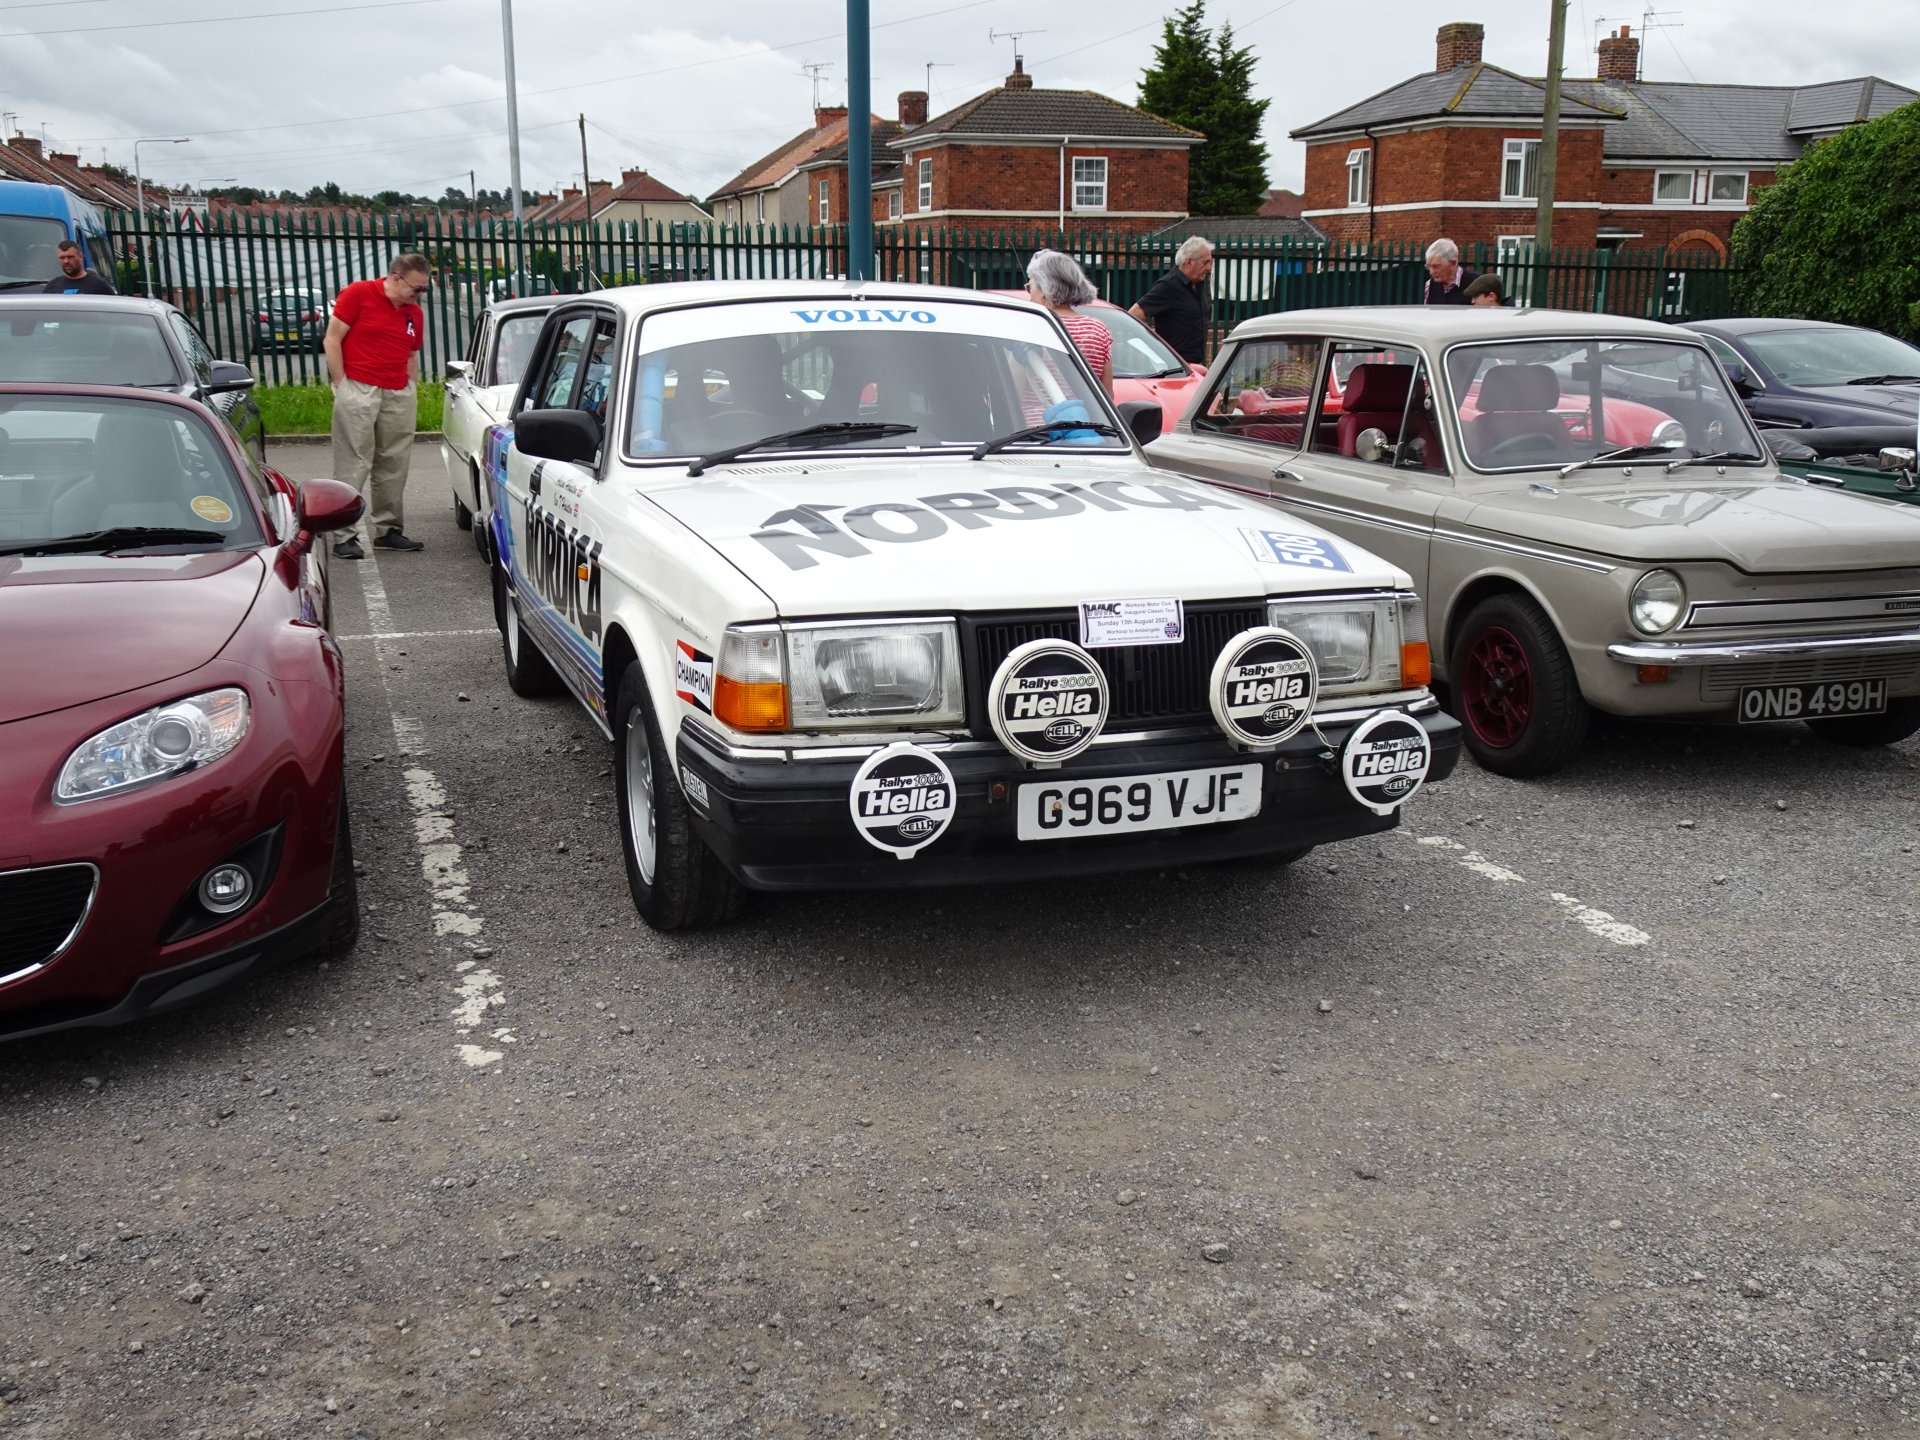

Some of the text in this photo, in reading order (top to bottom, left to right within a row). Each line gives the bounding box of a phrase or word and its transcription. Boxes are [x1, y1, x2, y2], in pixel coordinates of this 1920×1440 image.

[790, 309, 936, 323] VOLVO
[749, 480, 1243, 571] NORDICA
[1267, 533, 1335, 568] 508
[524, 495, 602, 648] NORDICA
[1097, 619, 1119, 627] Sunday
[678, 660, 711, 696] CHAMPION
[1240, 660, 1308, 678] Rallye 3000
[1019, 675, 1096, 690] Rallye 3000
[1234, 676, 1304, 705] Hella
[1013, 692, 1092, 718] Hella
[1744, 681, 1883, 719] ONB 499H
[1264, 707, 1296, 721] HELLA
[1047, 724, 1082, 737] HELLA
[1371, 741, 1398, 752] Rallye
[1357, 750, 1423, 776] Hella
[879, 772, 945, 788] Rallye 1000
[1384, 778, 1412, 791] HELLA
[865, 788, 945, 815] Hella
[1038, 772, 1243, 830] G969 VJF
[900, 820, 934, 832] HELLA
